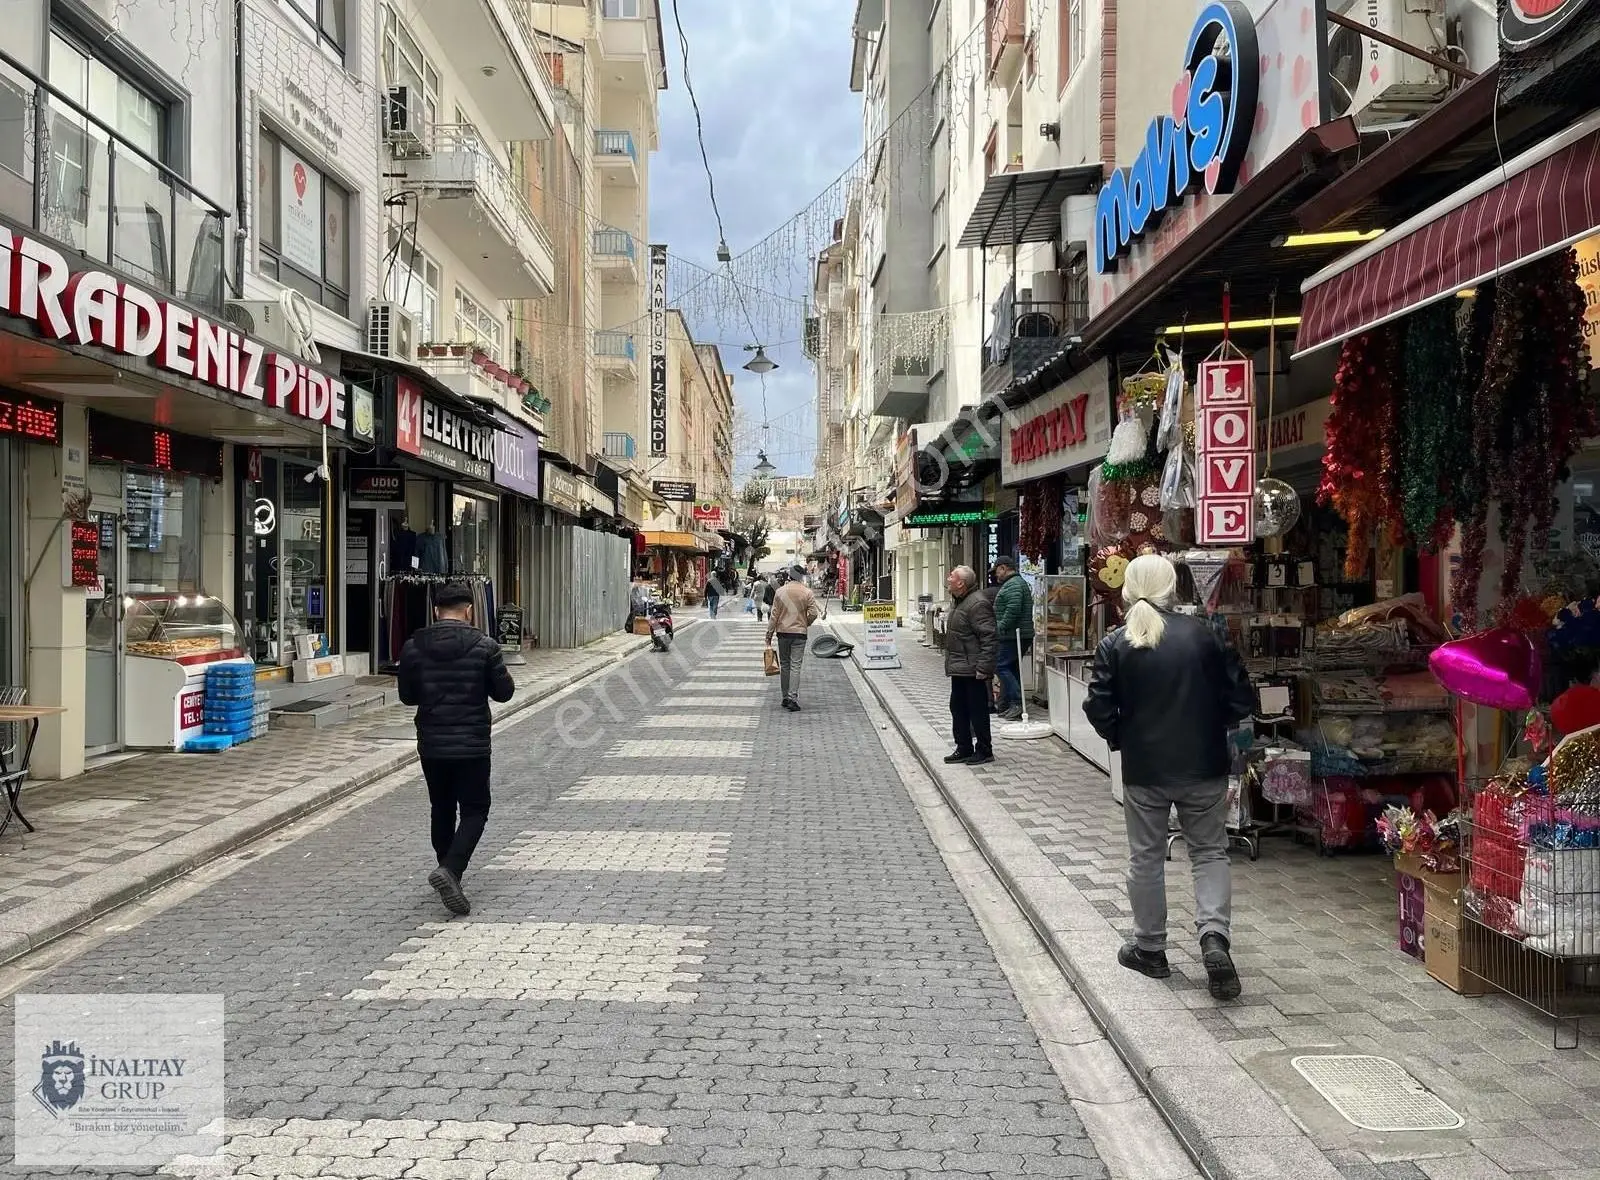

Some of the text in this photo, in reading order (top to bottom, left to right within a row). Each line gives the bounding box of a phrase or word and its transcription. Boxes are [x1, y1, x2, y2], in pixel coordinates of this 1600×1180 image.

[399, 389, 421, 448] 41
[1010, 393, 1089, 465] MERTAY
[1208, 367, 1245, 537] LOVE
